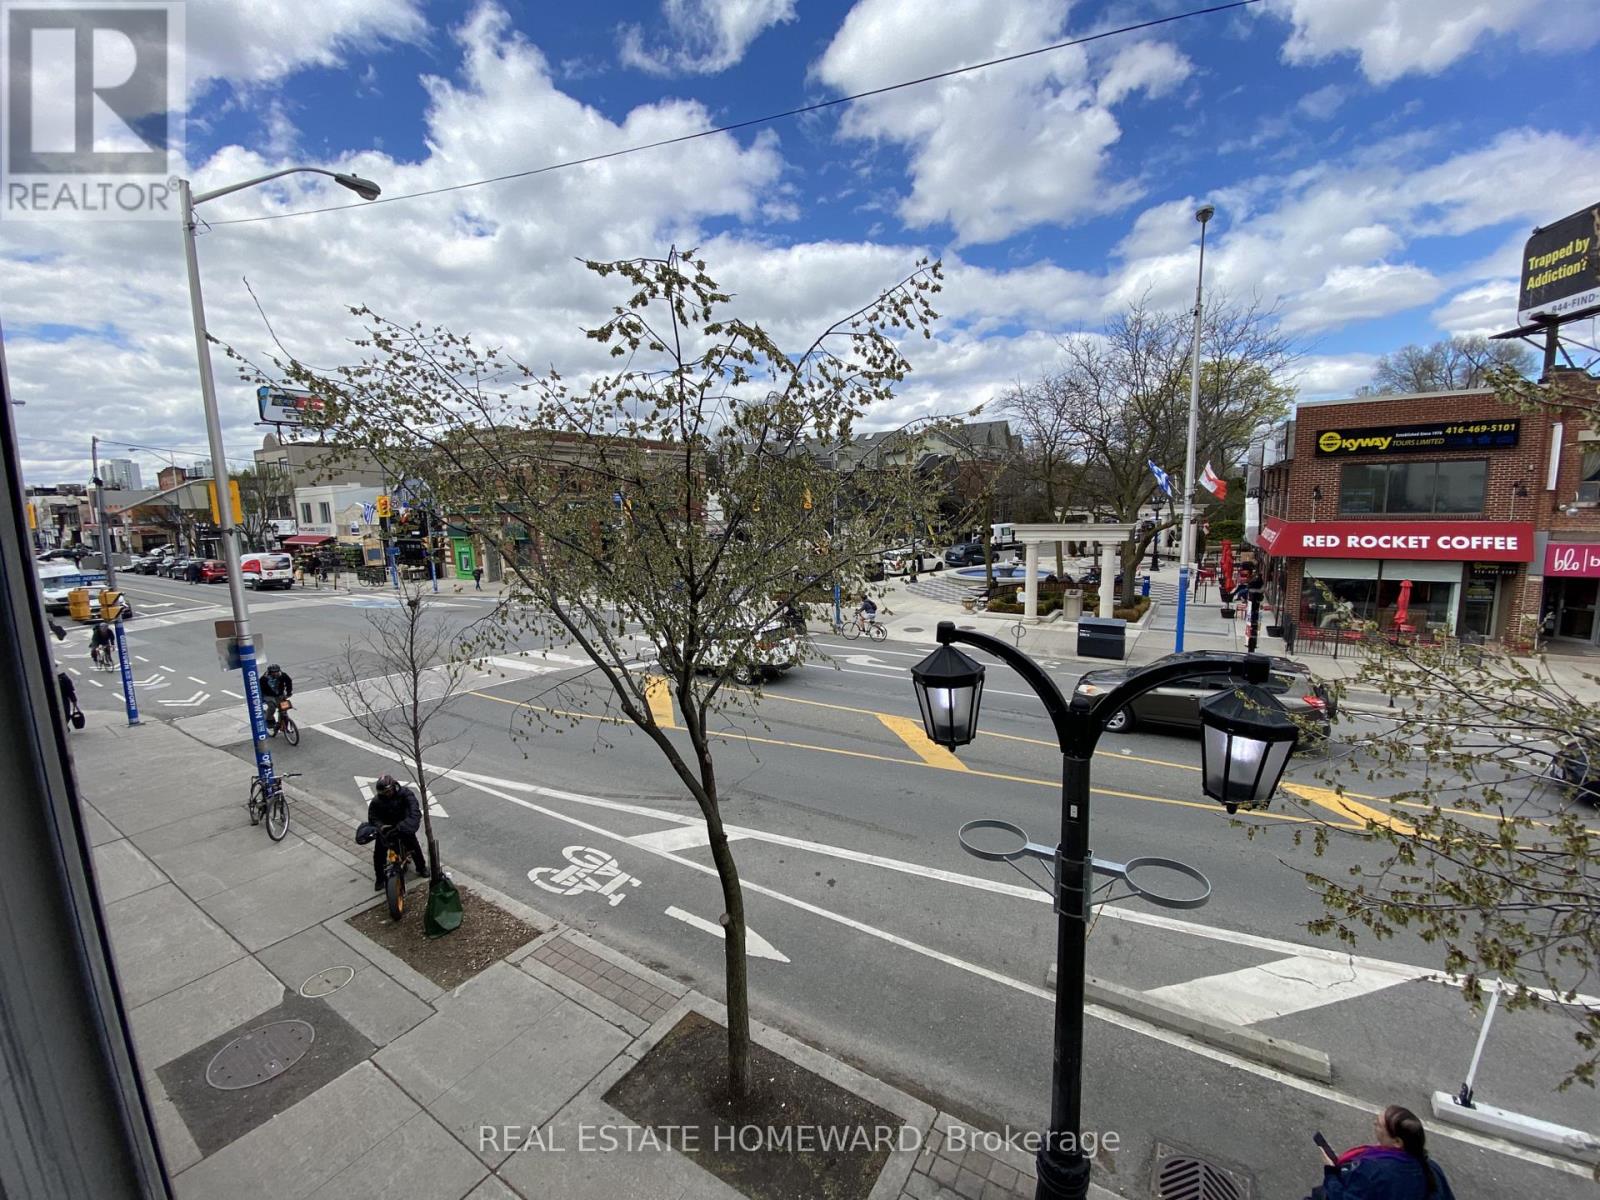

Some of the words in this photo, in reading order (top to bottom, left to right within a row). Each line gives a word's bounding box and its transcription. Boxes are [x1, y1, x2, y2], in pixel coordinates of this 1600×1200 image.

[1528, 241, 1573, 271] Trapped
[1575, 237, 1590, 254] by
[1526, 258, 1588, 291] Addiction?
[1445, 423, 1515, 435] 416-469-5101
[1392, 439, 1415, 447] TOURS
[1416, 438, 1445, 446] LIMITED
[1302, 535, 1341, 548] RED
[1347, 535, 1430, 549] ROCKET
[1437, 536, 1518, 550] COFFEE
[1553, 548, 1580, 572] blo
[247, 670, 263, 719] GREEKTOWN
